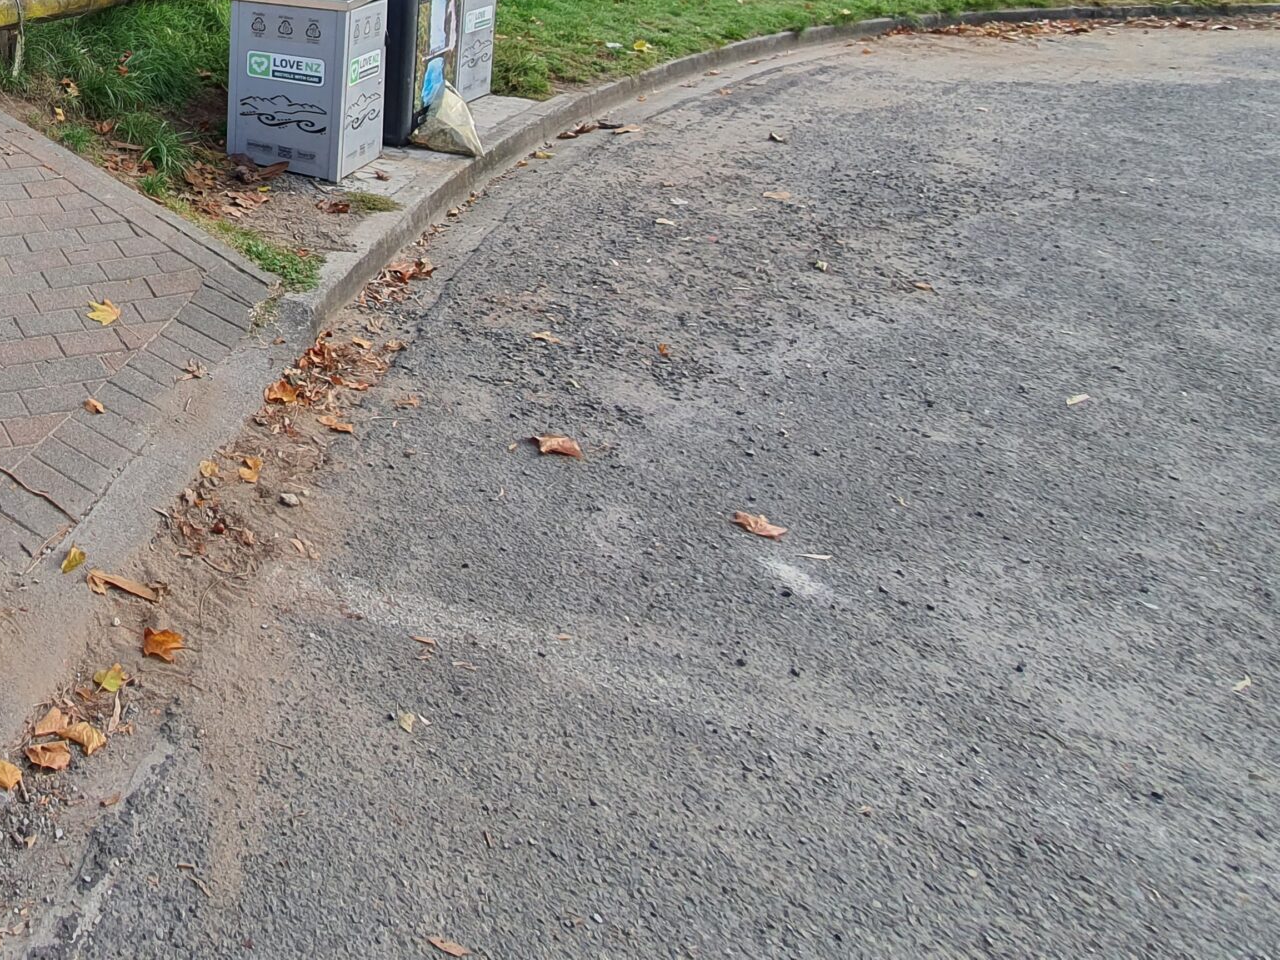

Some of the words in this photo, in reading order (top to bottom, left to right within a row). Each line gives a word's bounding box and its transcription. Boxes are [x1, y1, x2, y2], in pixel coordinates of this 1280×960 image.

[273, 57, 303, 70] LOVE
[305, 62, 321, 73] NZ
[360, 56, 372, 69] LOVE
[372, 54, 380, 65] NZ
